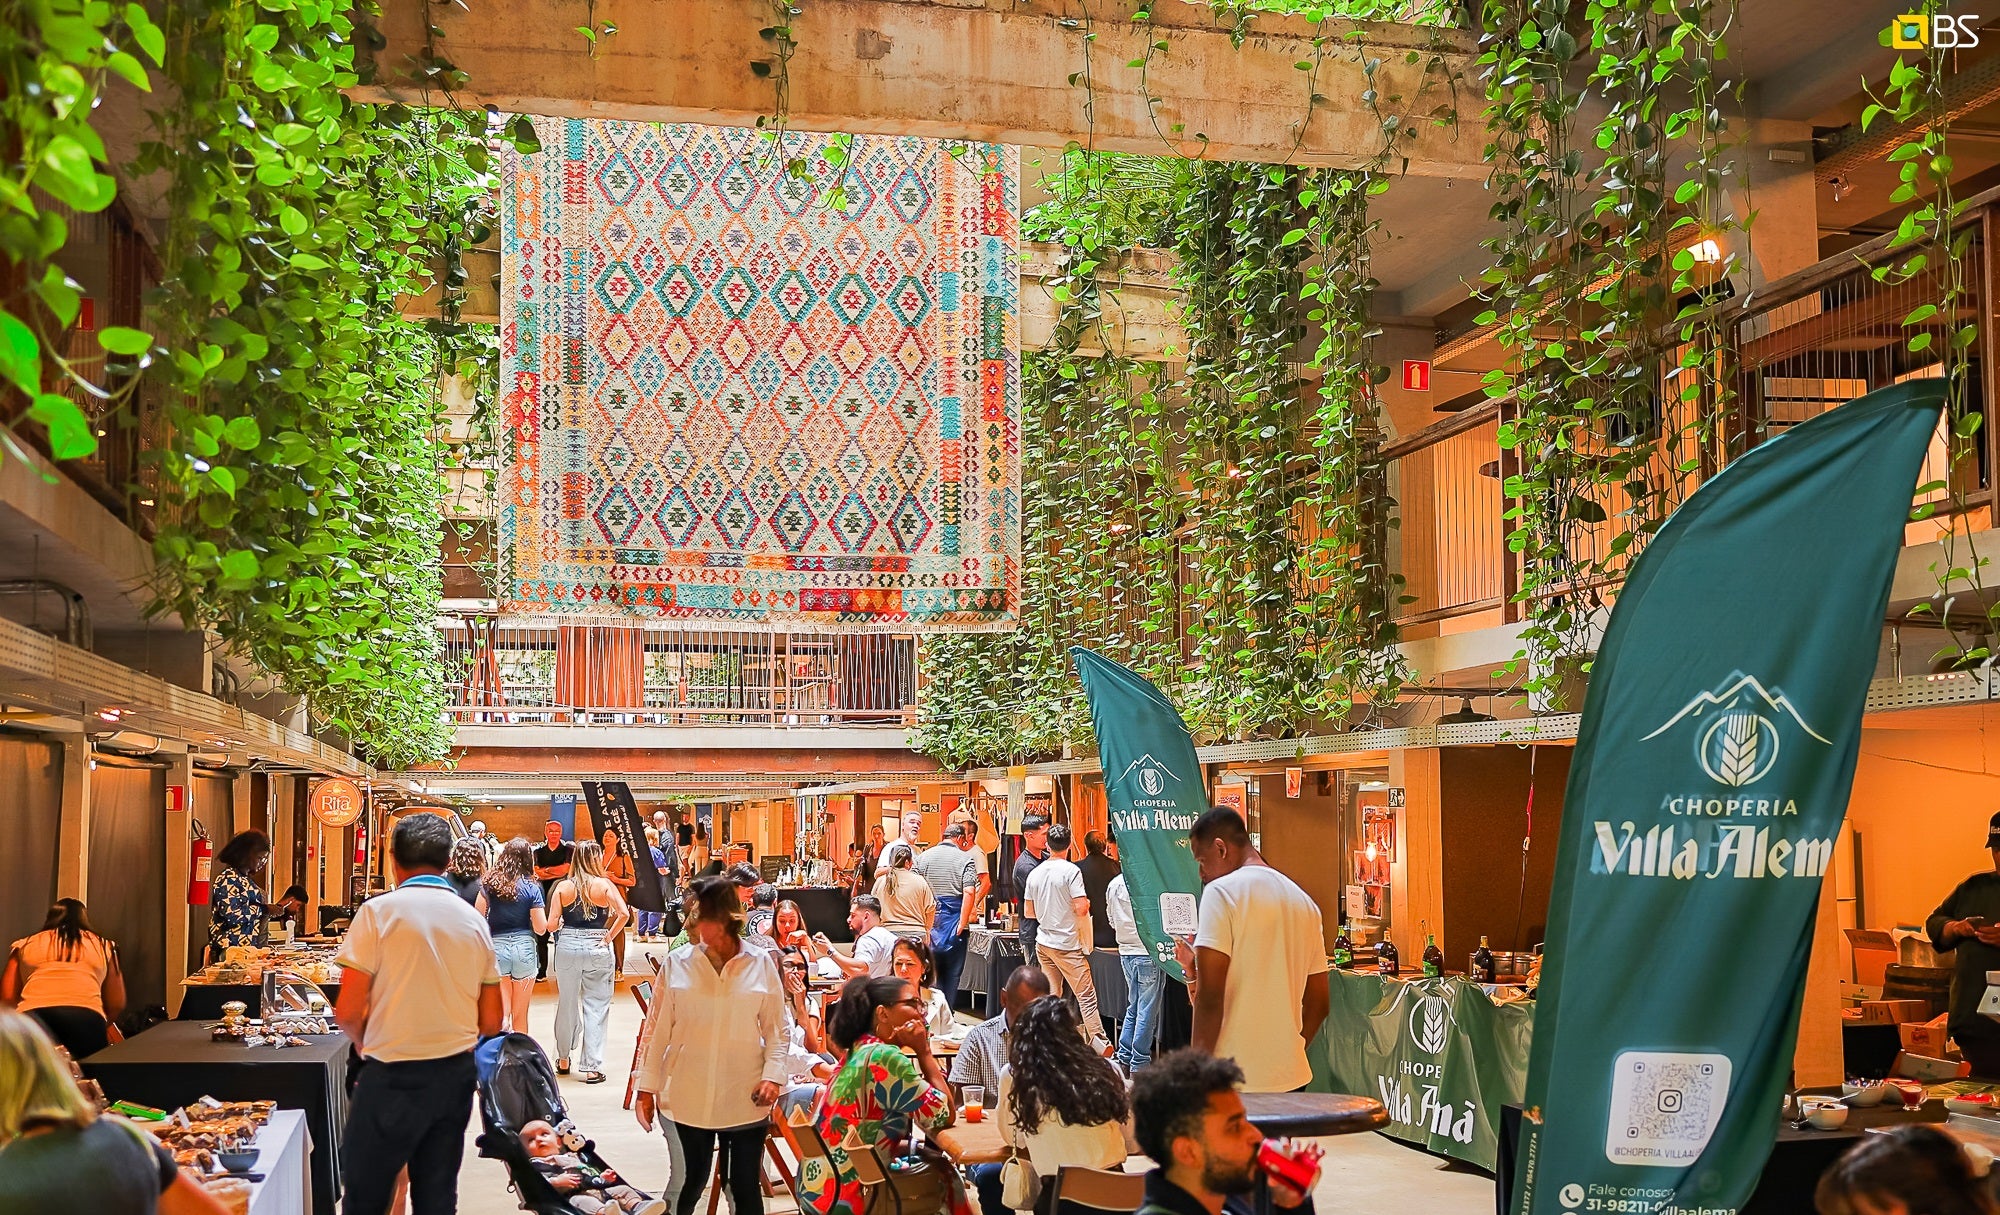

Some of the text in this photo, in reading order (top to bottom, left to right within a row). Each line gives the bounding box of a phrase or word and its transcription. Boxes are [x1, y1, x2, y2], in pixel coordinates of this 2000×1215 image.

[321, 795, 352, 811] Rita
[1133, 799, 1177, 807] CHOPERIA
[1669, 798, 1798, 816] CHOPERIA
[1112, 809, 1150, 831] Villa
[1594, 820, 1833, 880] Villa Alem
[1588, 1183, 1617, 1196] Fale
